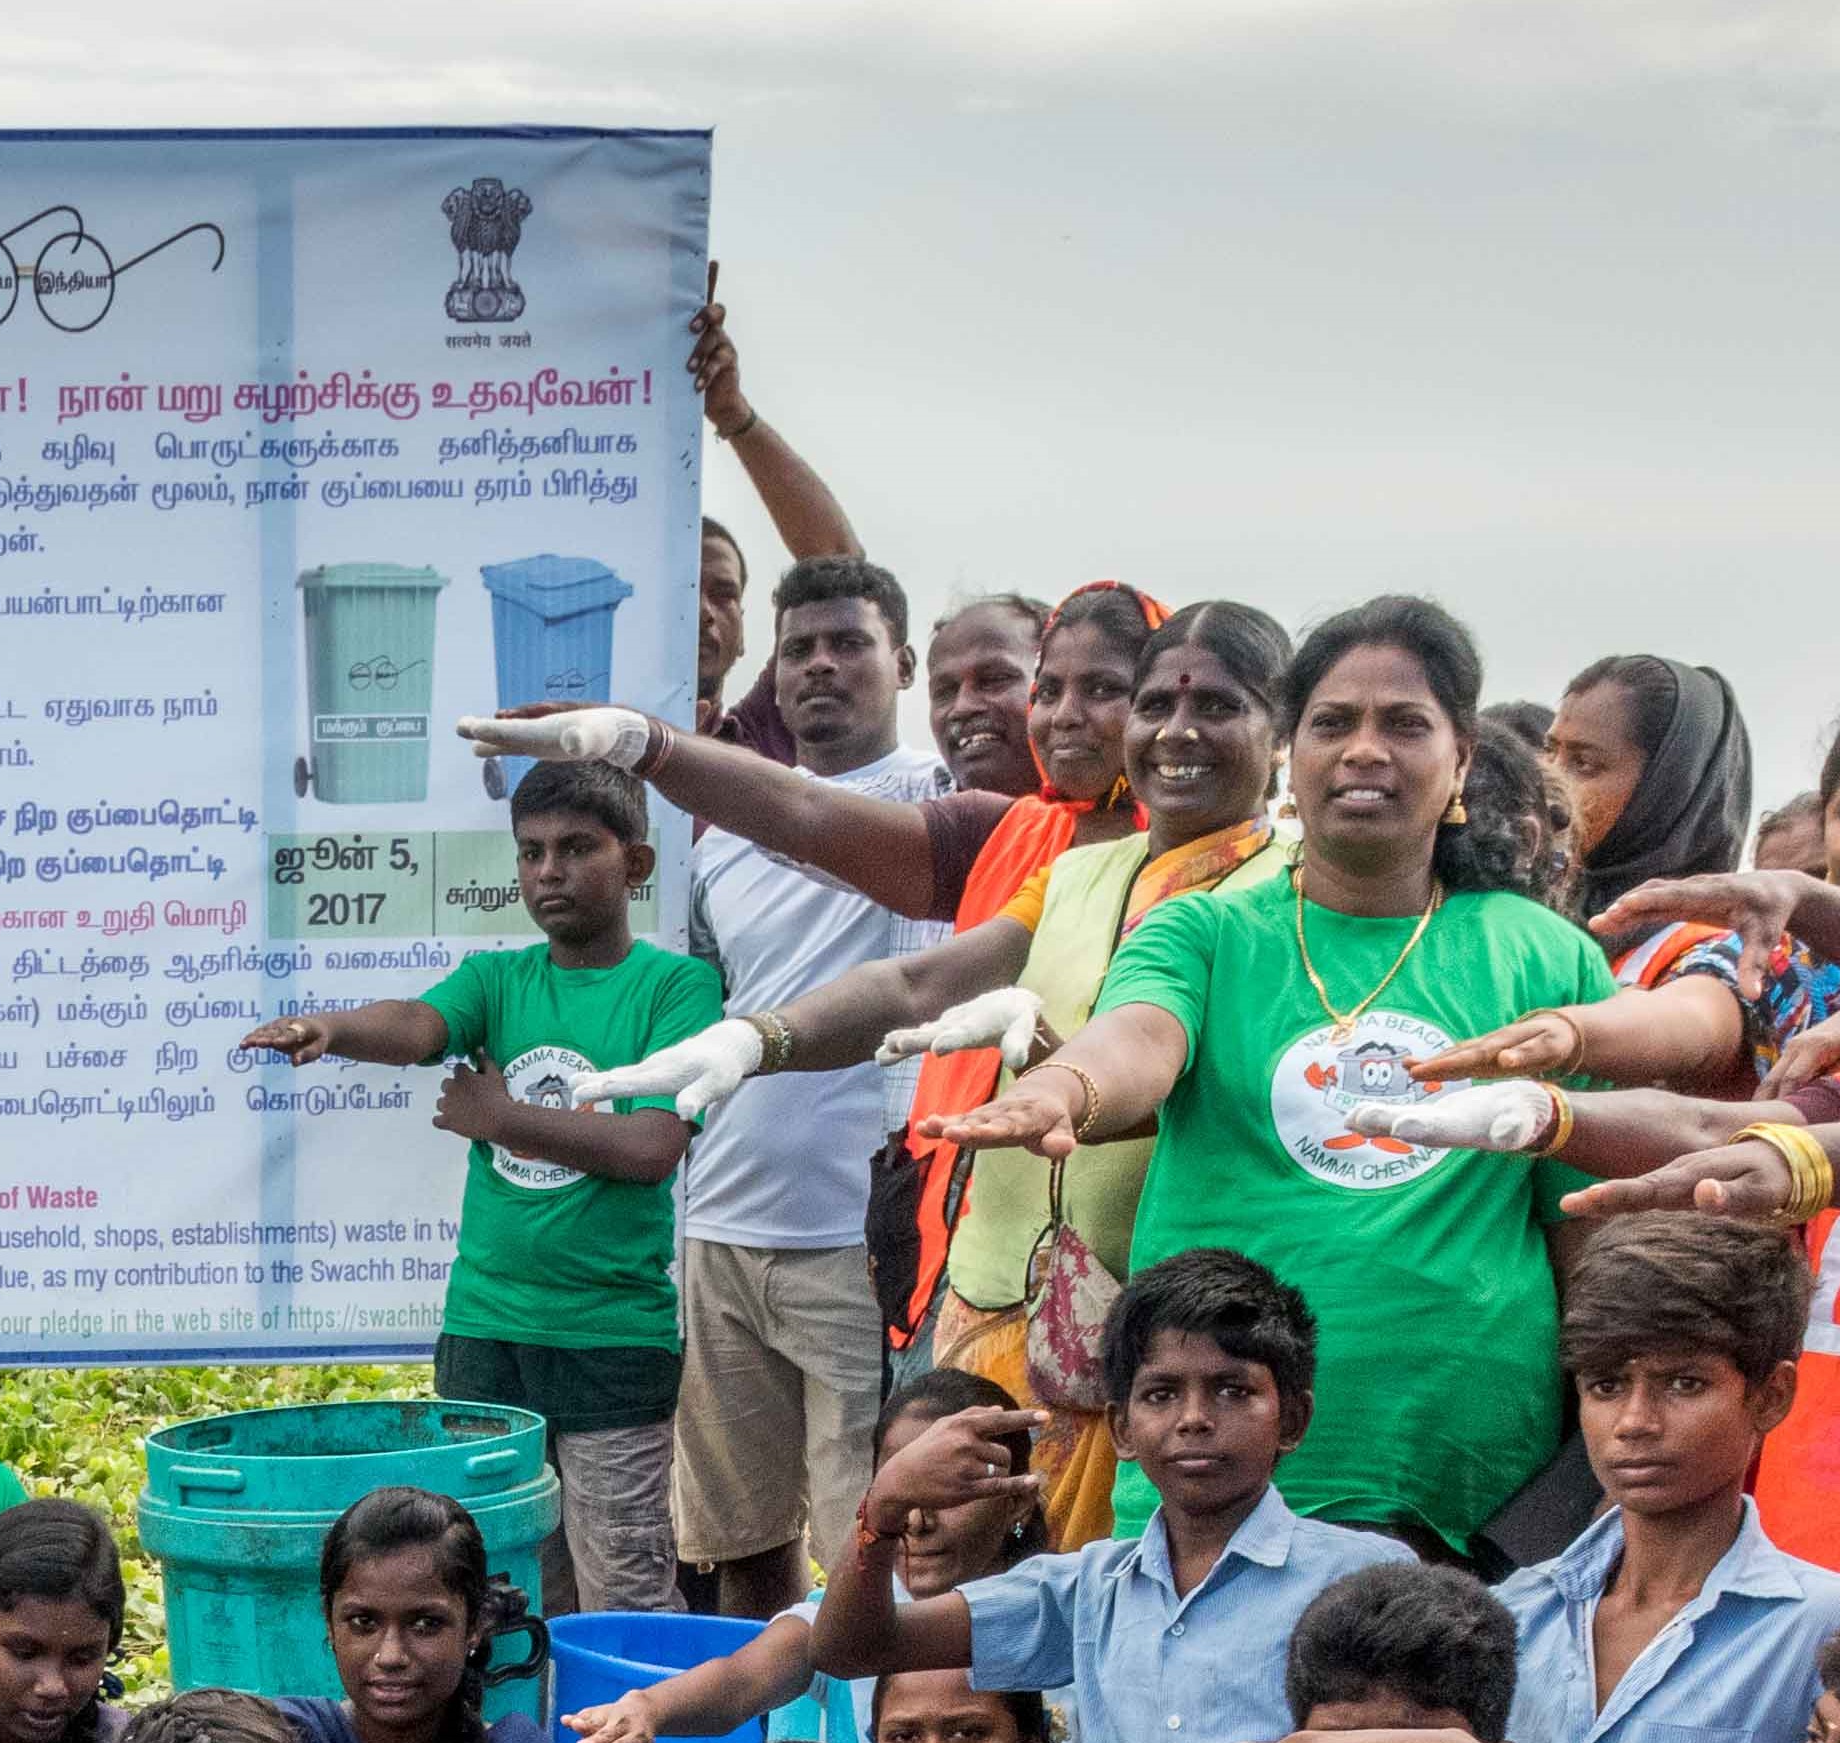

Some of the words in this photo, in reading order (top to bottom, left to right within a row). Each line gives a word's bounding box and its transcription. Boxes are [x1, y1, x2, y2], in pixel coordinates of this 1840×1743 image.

[58, 372, 146, 423] நான்
[159, 389, 220, 423] மறு
[42, 433, 114, 470] கழிவு
[156, 430, 399, 467] பொருட்களுக்காக
[439, 427, 637, 465] தனித்தனியாக
[152, 472, 236, 509] மூலம்,
[245, 472, 309, 509] நான்
[322, 472, 462, 508] குப்பையை
[475, 470, 530, 507] தரம்
[543, 468, 637, 504] பிரித்து
[163, 689, 218, 725] நாம்
[15, 803, 55, 837] நிற
[66, 797, 260, 836] குப்பைதொட்டி
[36, 845, 228, 882] குப்பைதொட்டி
[275, 835, 378, 885] ஜூன்
[389, 838, 419, 876] 5,
[76, 899, 154, 935] உறுதி
[164, 898, 247, 935] மொழி
[308, 893, 386, 926] 2017
[13, 945, 150, 984] திட்டத்தை
[164, 941, 312, 984] ஆதரிக்கும்
[325, 940, 451, 972] வகையில்
[57, 994, 148, 1027] மக்கும்
[46, 1042, 128, 1071] பச்சை
[156, 1044, 198, 1075] நிற
[246, 1084, 412, 1116] கொடுப்பேன்
[1295, 1135, 1357, 1180] NAMMA
[27, 1185, 98, 1209] Waste
[94, 1222, 163, 1252] shops,
[171, 1221, 336, 1250] establishments)
[345, 1222, 406, 1242] waste
[414, 1218, 432, 1241] in
[43, 1270, 66, 1287] as
[74, 1268, 106, 1292] my
[115, 1261, 238, 1286] contribution
[246, 1264, 264, 1284] to
[272, 1260, 302, 1284] the
[311, 1258, 394, 1282] Swachh
[39, 1308, 104, 1339] pledge
[111, 1308, 128, 1331] in
[136, 1308, 164, 1331] the
[180, 1306, 212, 1331] web
[220, 1305, 253, 1330] site
[262, 1304, 281, 1328] of
[287, 1302, 443, 1334] https://swachhb
